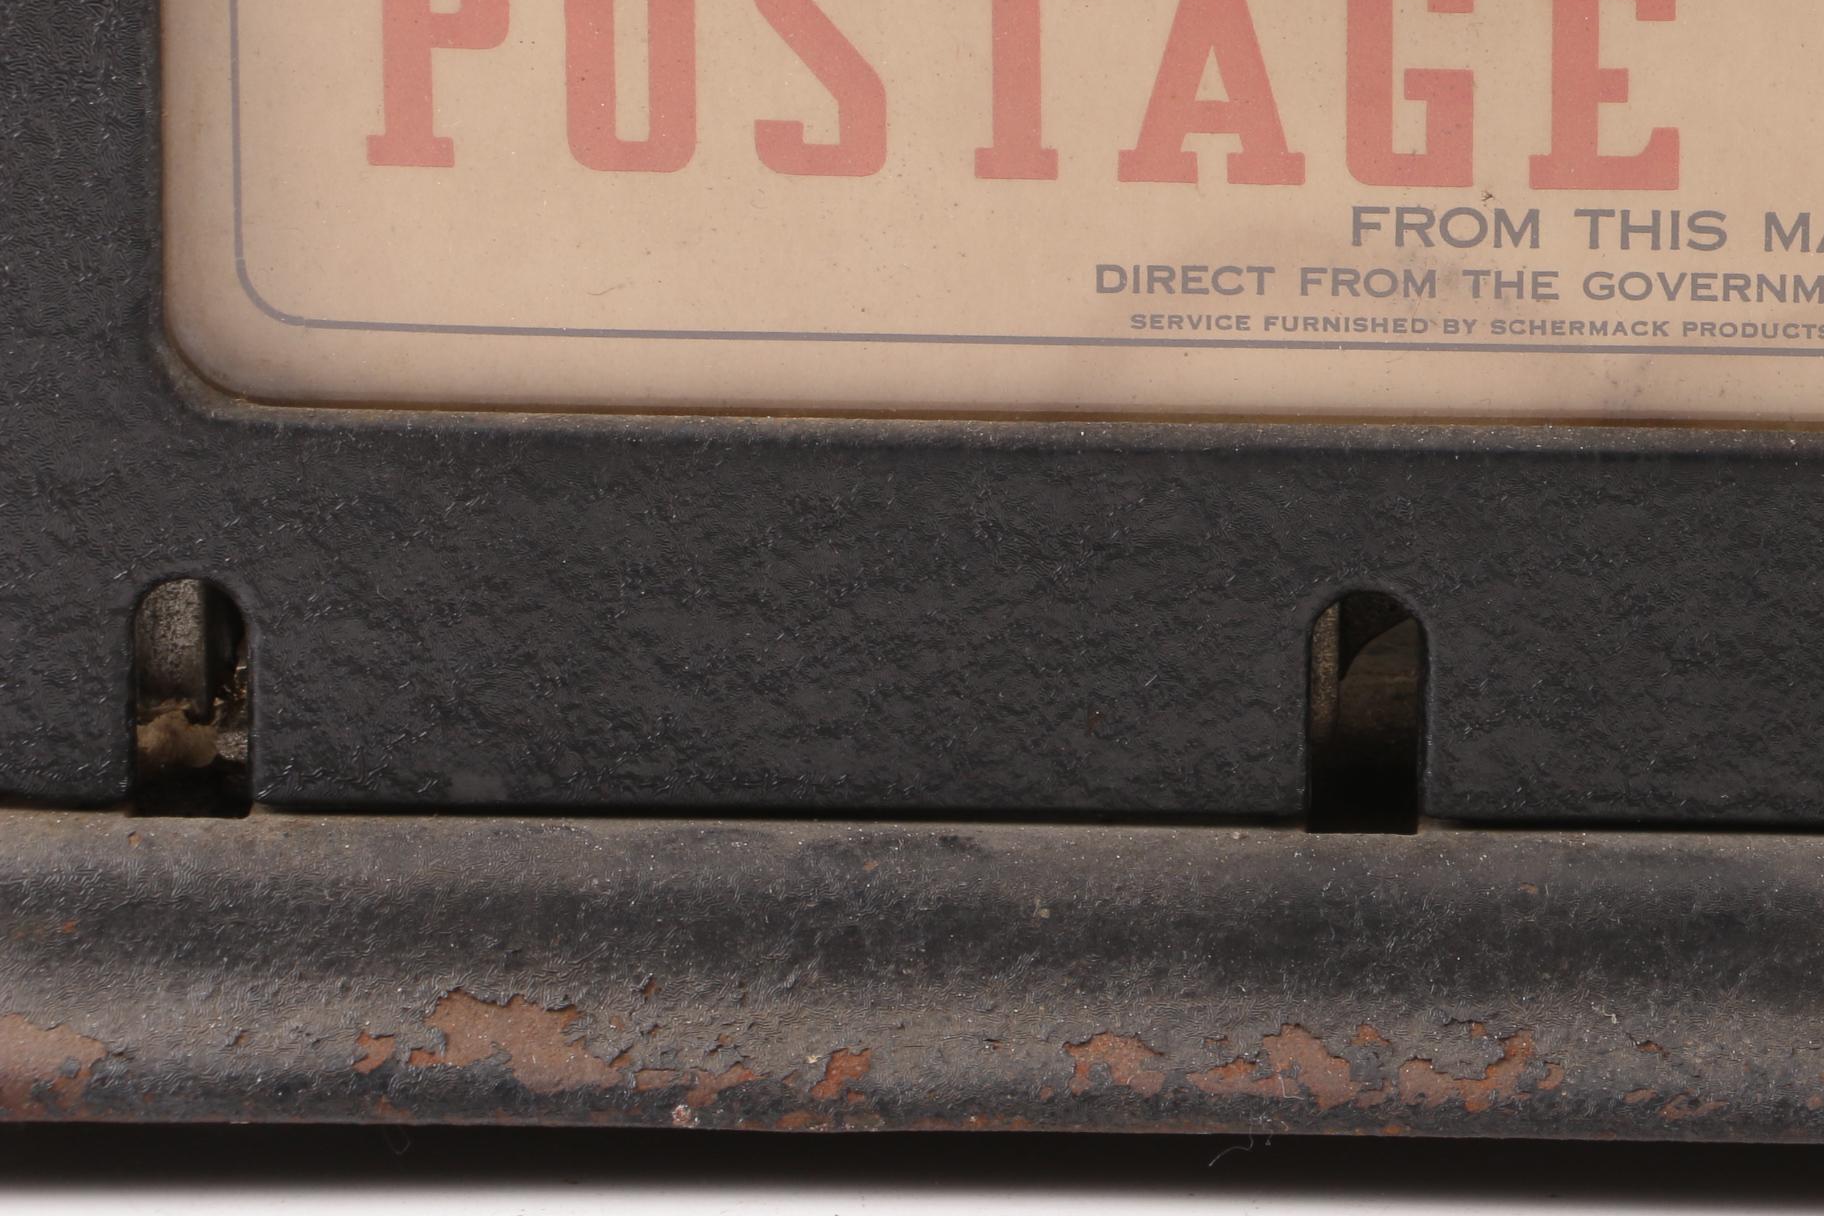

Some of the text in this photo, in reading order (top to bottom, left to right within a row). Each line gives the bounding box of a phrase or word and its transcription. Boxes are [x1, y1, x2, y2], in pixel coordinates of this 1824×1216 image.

[1350, 205, 1541, 249] FROM
[1573, 208, 1728, 252] THIS
[1095, 264, 1276, 296] DIRECT
[1299, 266, 1438, 299] FROM
[1461, 269, 1560, 301] THE
[1130, 313, 1252, 333] SERVICE
[1262, 315, 1430, 336] FURNISHED
[1442, 318, 1479, 336] BY
[1489, 319, 1671, 338] SCHERMACK
